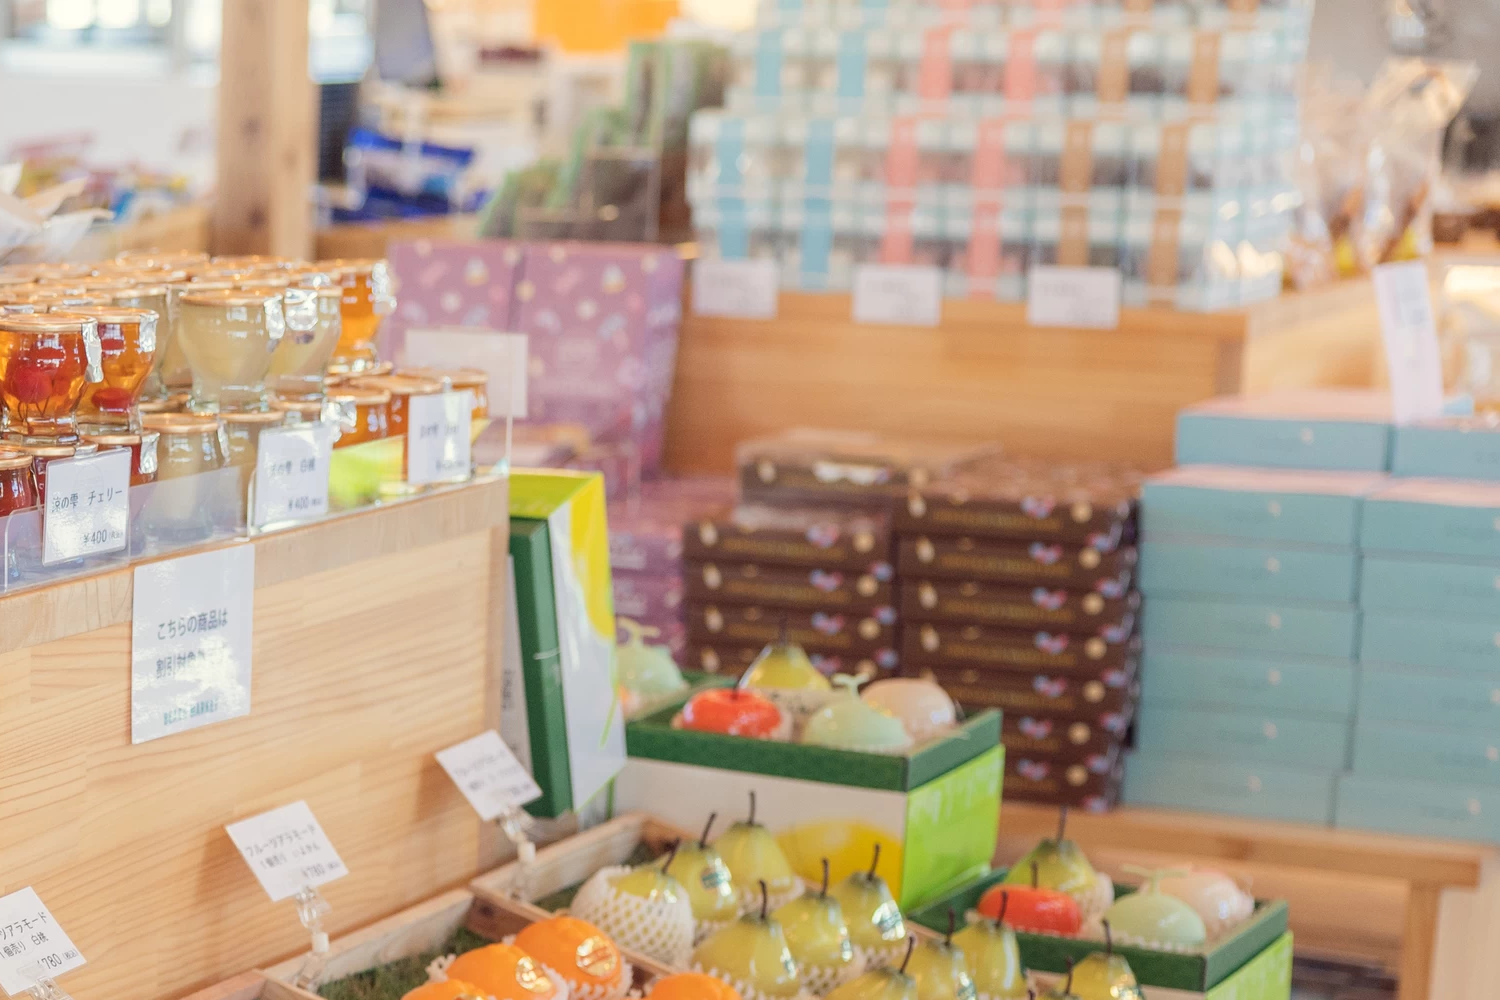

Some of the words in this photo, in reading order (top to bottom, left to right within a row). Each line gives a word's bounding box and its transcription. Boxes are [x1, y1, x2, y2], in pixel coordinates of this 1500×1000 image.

[88, 487, 123, 506] チェリー
[157, 608, 228, 640] こちらの商品は
[245, 823, 317, 857] フルーツアラモード
[30, 931, 49, 946] 白桃
